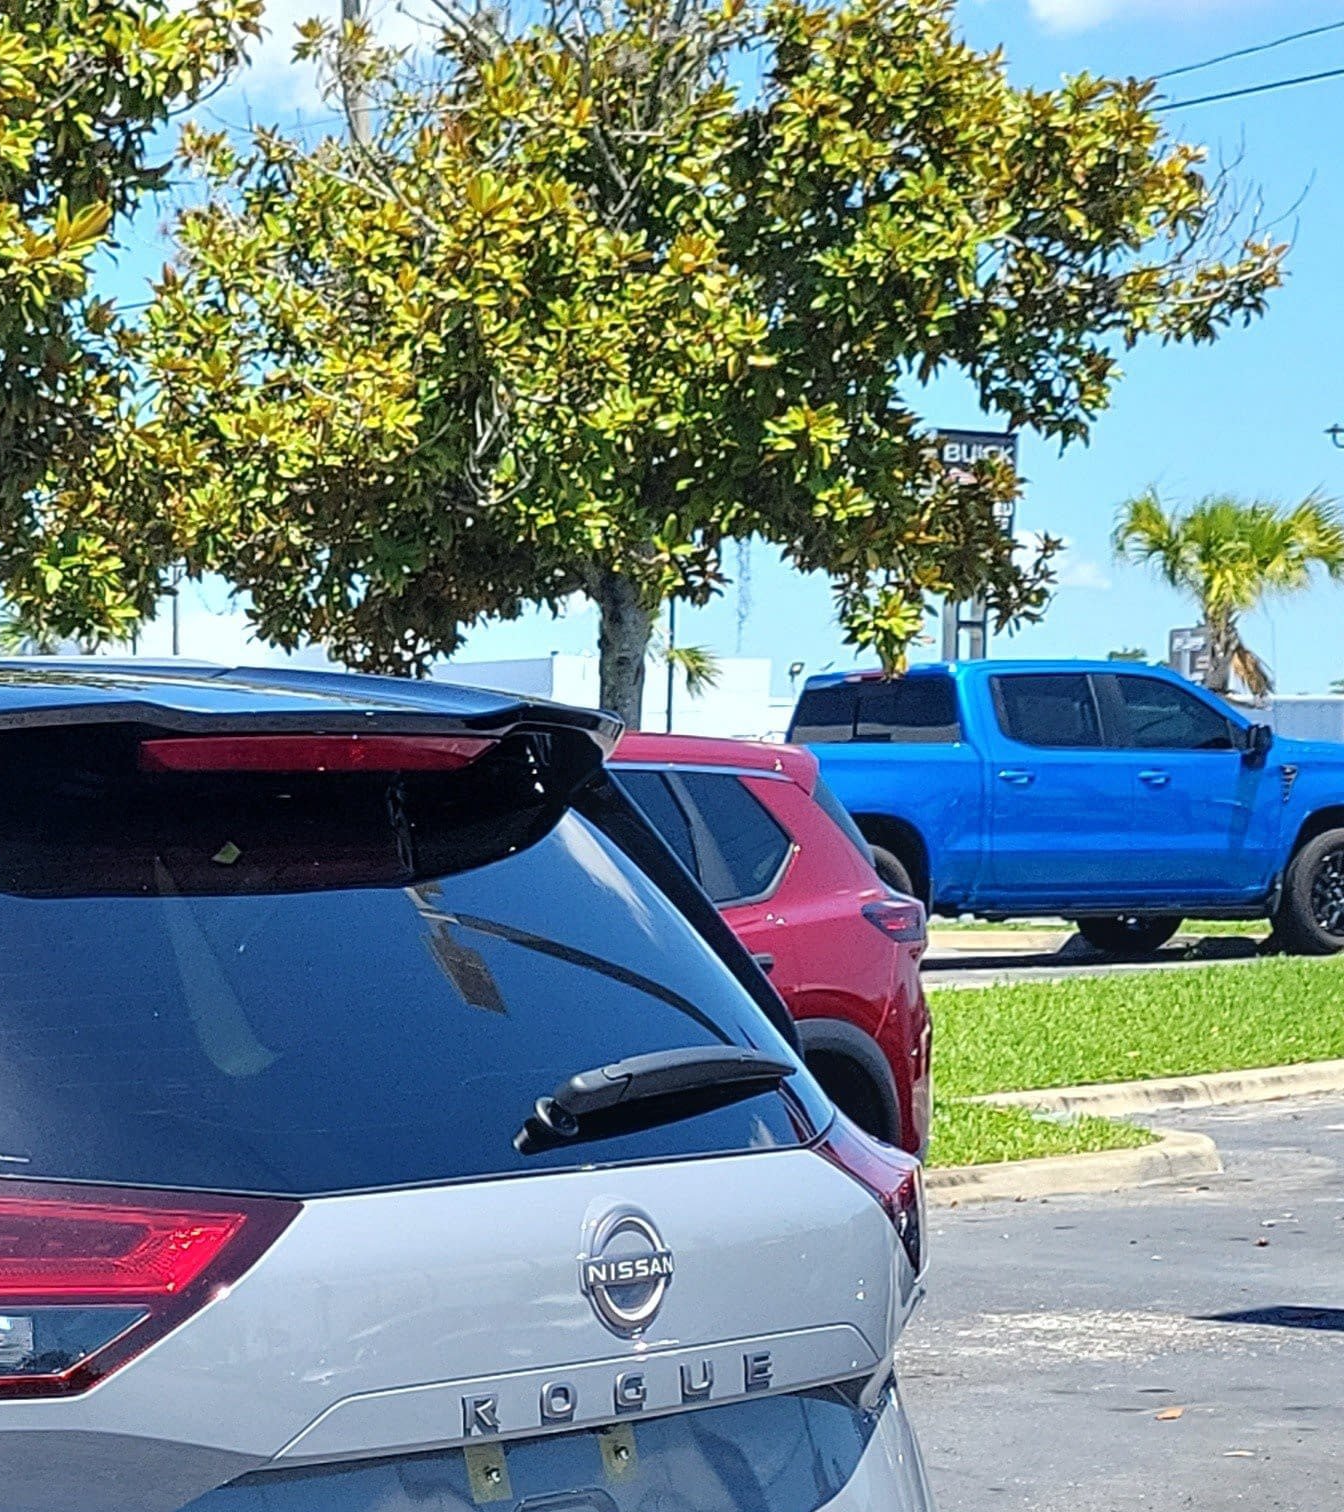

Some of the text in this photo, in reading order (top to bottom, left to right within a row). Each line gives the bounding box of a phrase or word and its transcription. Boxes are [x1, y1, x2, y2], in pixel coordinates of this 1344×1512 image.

[943, 443, 1014, 465] BUICK
[588, 1255, 673, 1282] NISSAN
[462, 1351, 774, 1436] ROGUE
